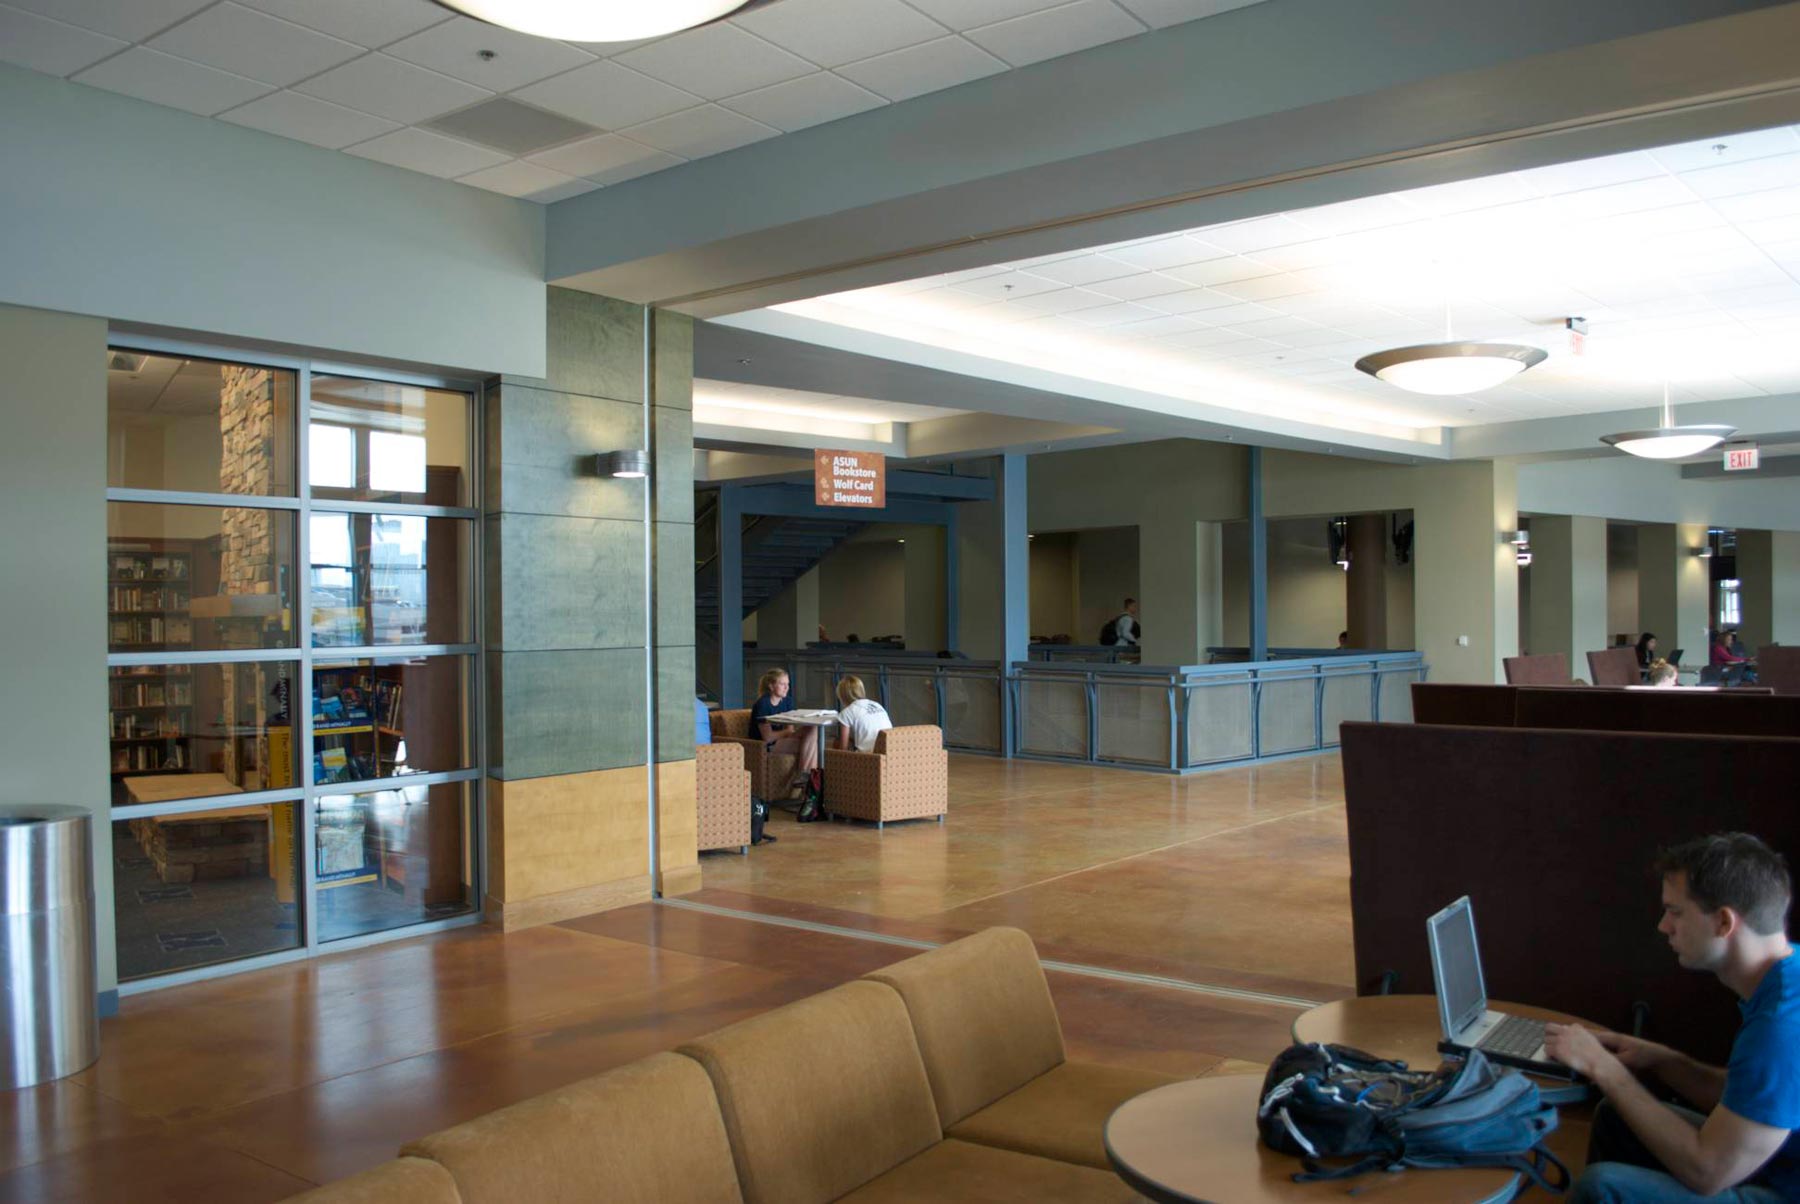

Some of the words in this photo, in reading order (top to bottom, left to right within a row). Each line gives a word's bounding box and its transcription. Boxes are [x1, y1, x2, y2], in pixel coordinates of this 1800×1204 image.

[833, 456, 858, 467] ASUN
[1730, 452, 1752, 468] EXIT
[833, 466, 876, 478] Bookstore
[833, 479, 854, 489] Wolf
[854, 480, 874, 491] Card
[834, 492, 873, 503] Elevators
